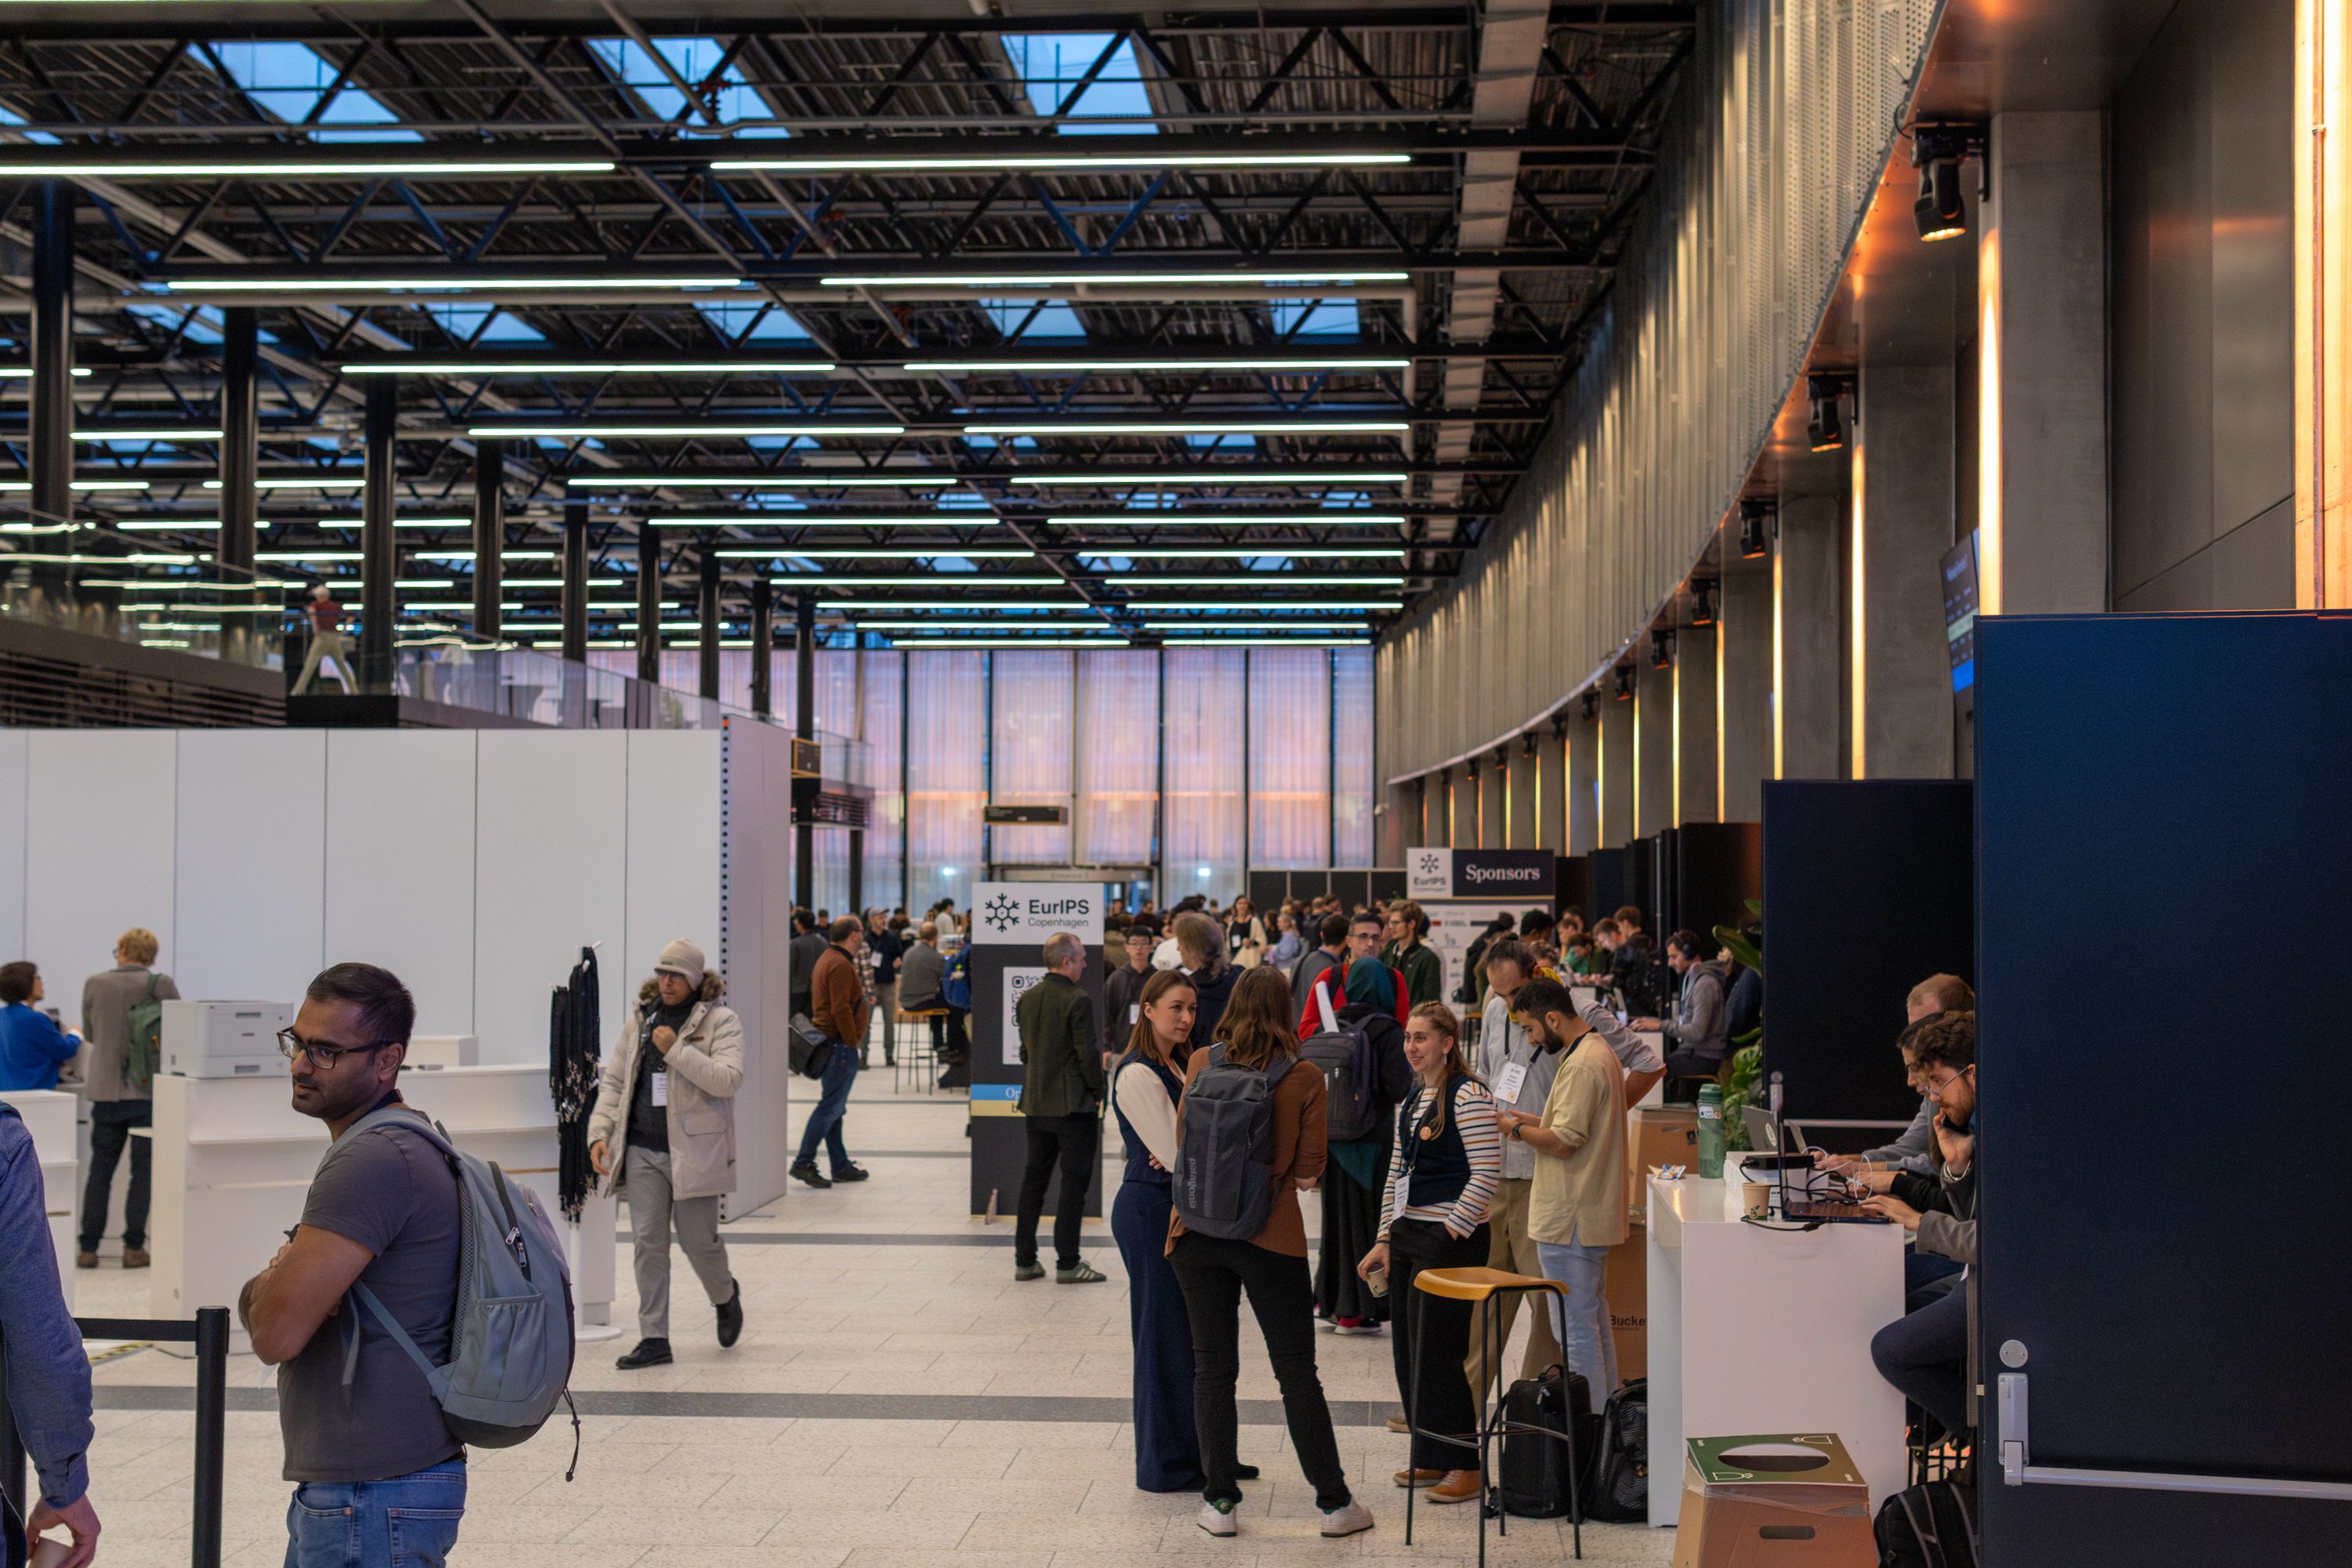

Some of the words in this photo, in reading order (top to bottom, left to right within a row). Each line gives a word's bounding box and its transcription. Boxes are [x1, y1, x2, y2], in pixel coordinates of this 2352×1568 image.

[1465, 864, 1541, 884] Sponsors
[1029, 899, 1090, 915] EurIPS
[1028, 917, 1089, 929] Copenhagen
[1187, 1157, 1198, 1209] patagonia
